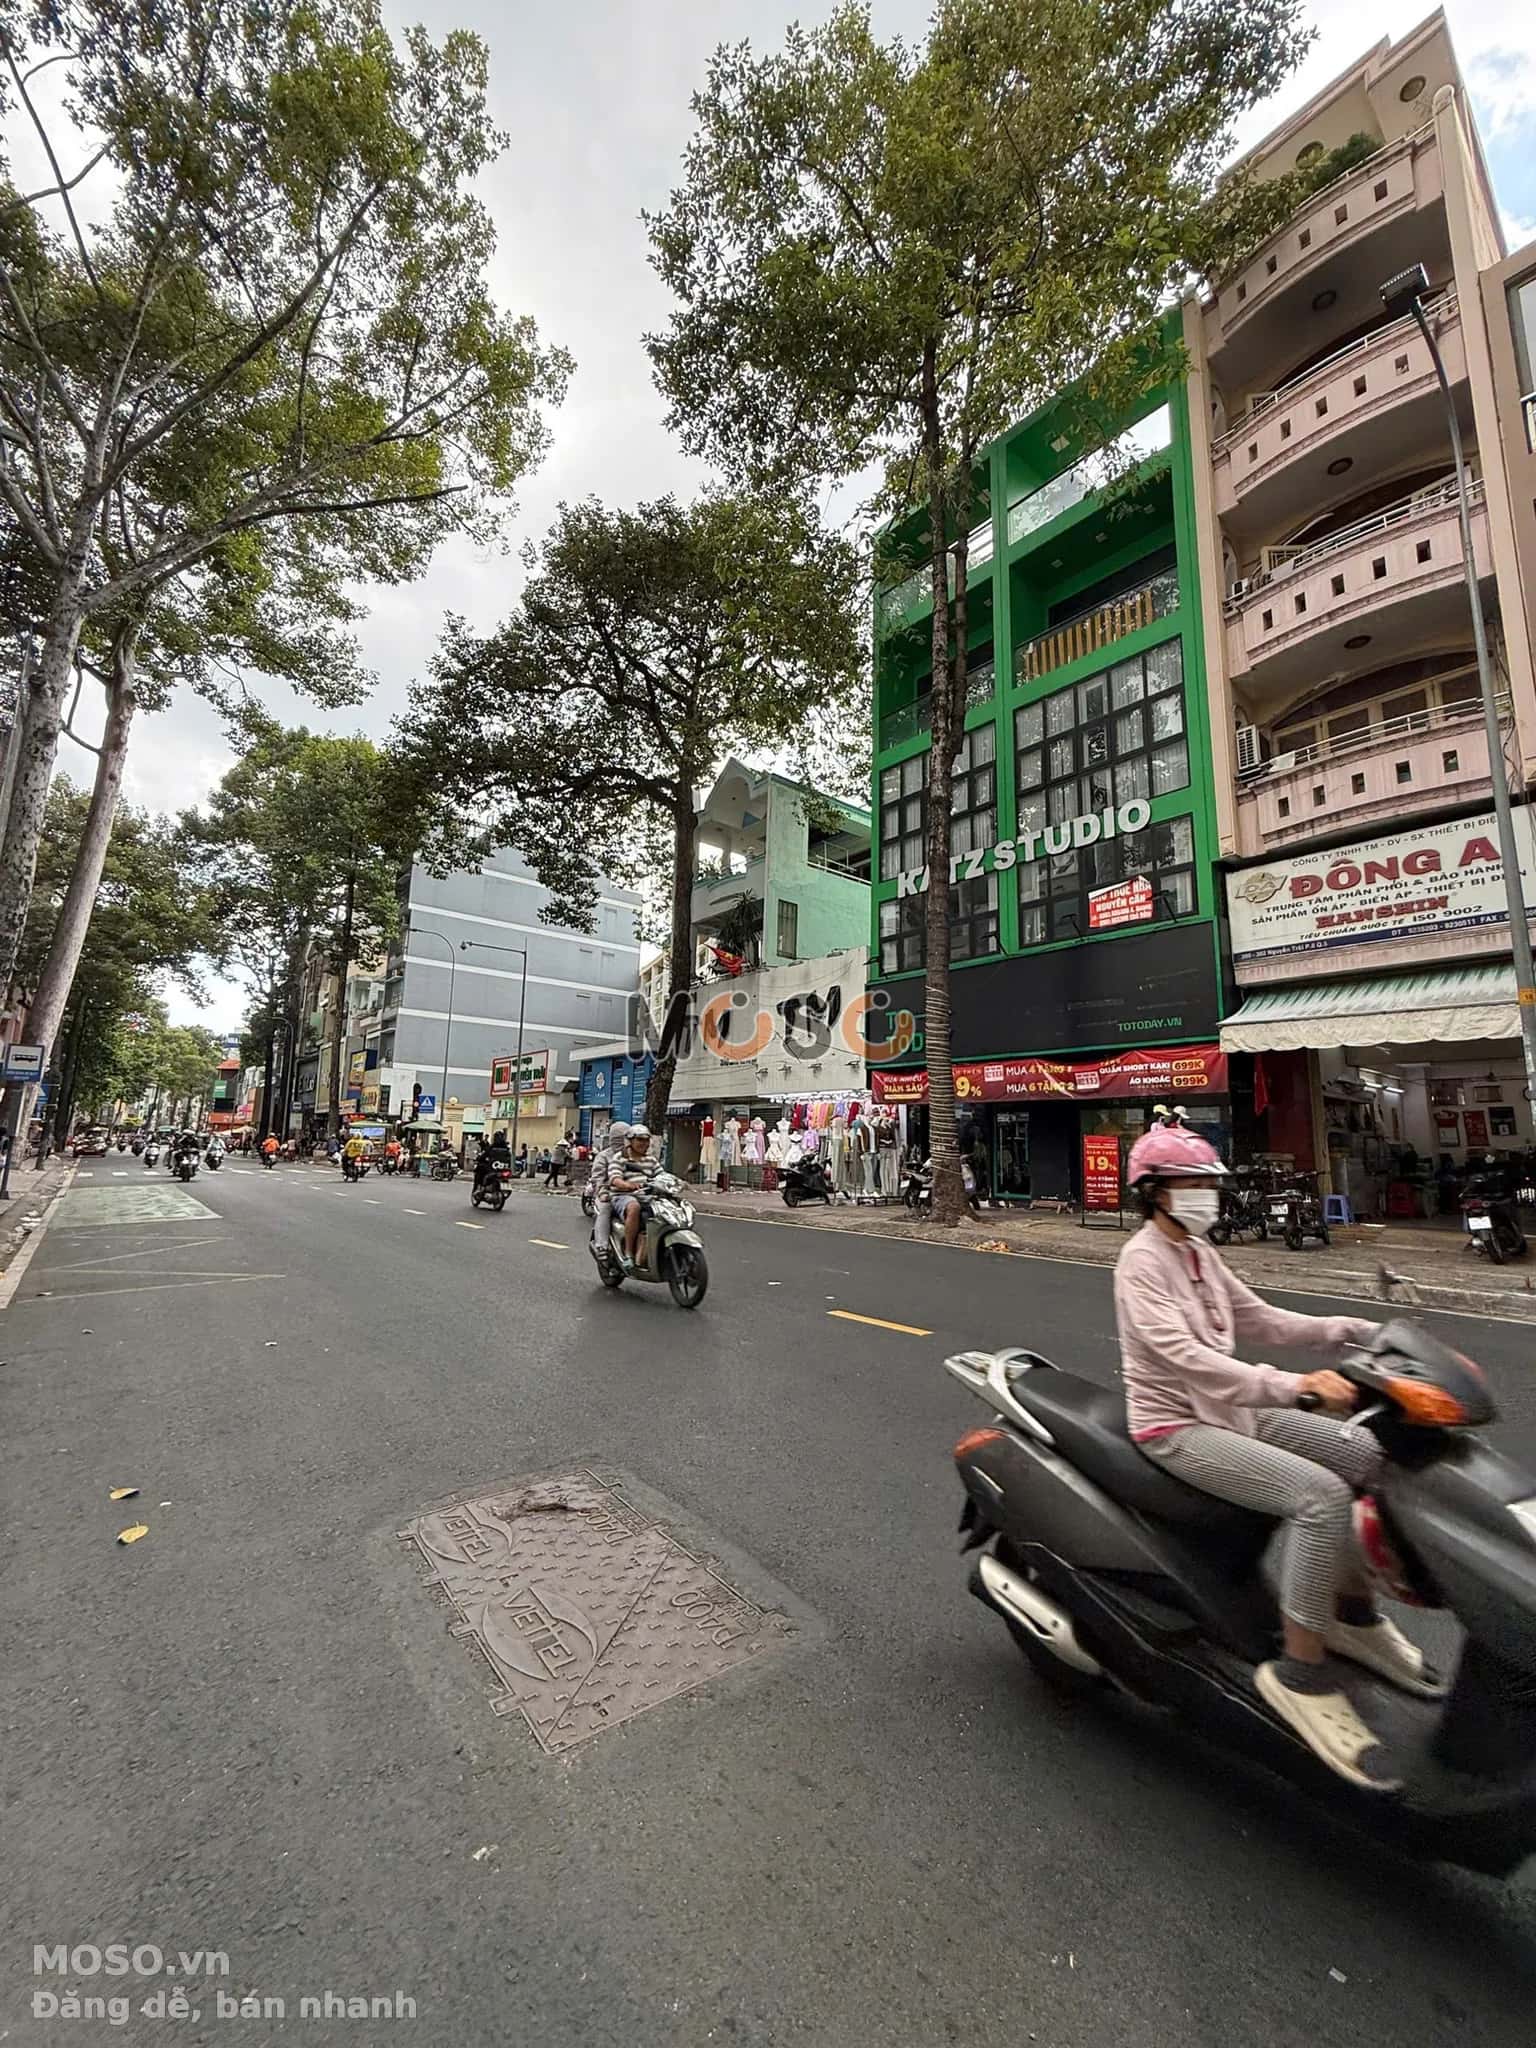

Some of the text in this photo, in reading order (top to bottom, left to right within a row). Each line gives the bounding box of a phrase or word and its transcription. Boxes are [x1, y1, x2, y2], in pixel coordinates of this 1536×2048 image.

[993, 798, 1152, 870] STUDIO
[1321, 853, 1332, 861] TY
[1335, 847, 1361, 857] TNHH
[1365, 843, 1378, 851] TM
[1387, 838, 1401, 847] DV
[1410, 833, 1425, 841] SX
[1288, 836, 1502, 899] ĐÔNG A
[1265, 902, 1303, 913] TRUNG
[1308, 894, 1333, 906] TÂM
[1337, 887, 1372, 903] PHÂN
[1315, 895, 1449, 929] HANSHIN
[1413, 912, 1437, 922] ISO
[1442, 905, 1483, 917] 9002
[1480, 914, 1497, 924] FAX
[1117, 1017, 1183, 1032] TOTODAY.VN
[1006, 1066, 1028, 1076] MUA
[1029, 1064, 1038, 1074] 4
[1123, 1063, 1149, 1071] SHORT
[1174, 1060, 1203, 1071] 699K
[1006, 1083, 1028, 1093] MUA
[1029, 1083, 1037, 1092] 6
[1067, 1082, 1075, 1090] 2
[1129, 1074, 1205, 1087] ÁO KHOÁC 999K
[1086, 1155, 1118, 1171] 19%
